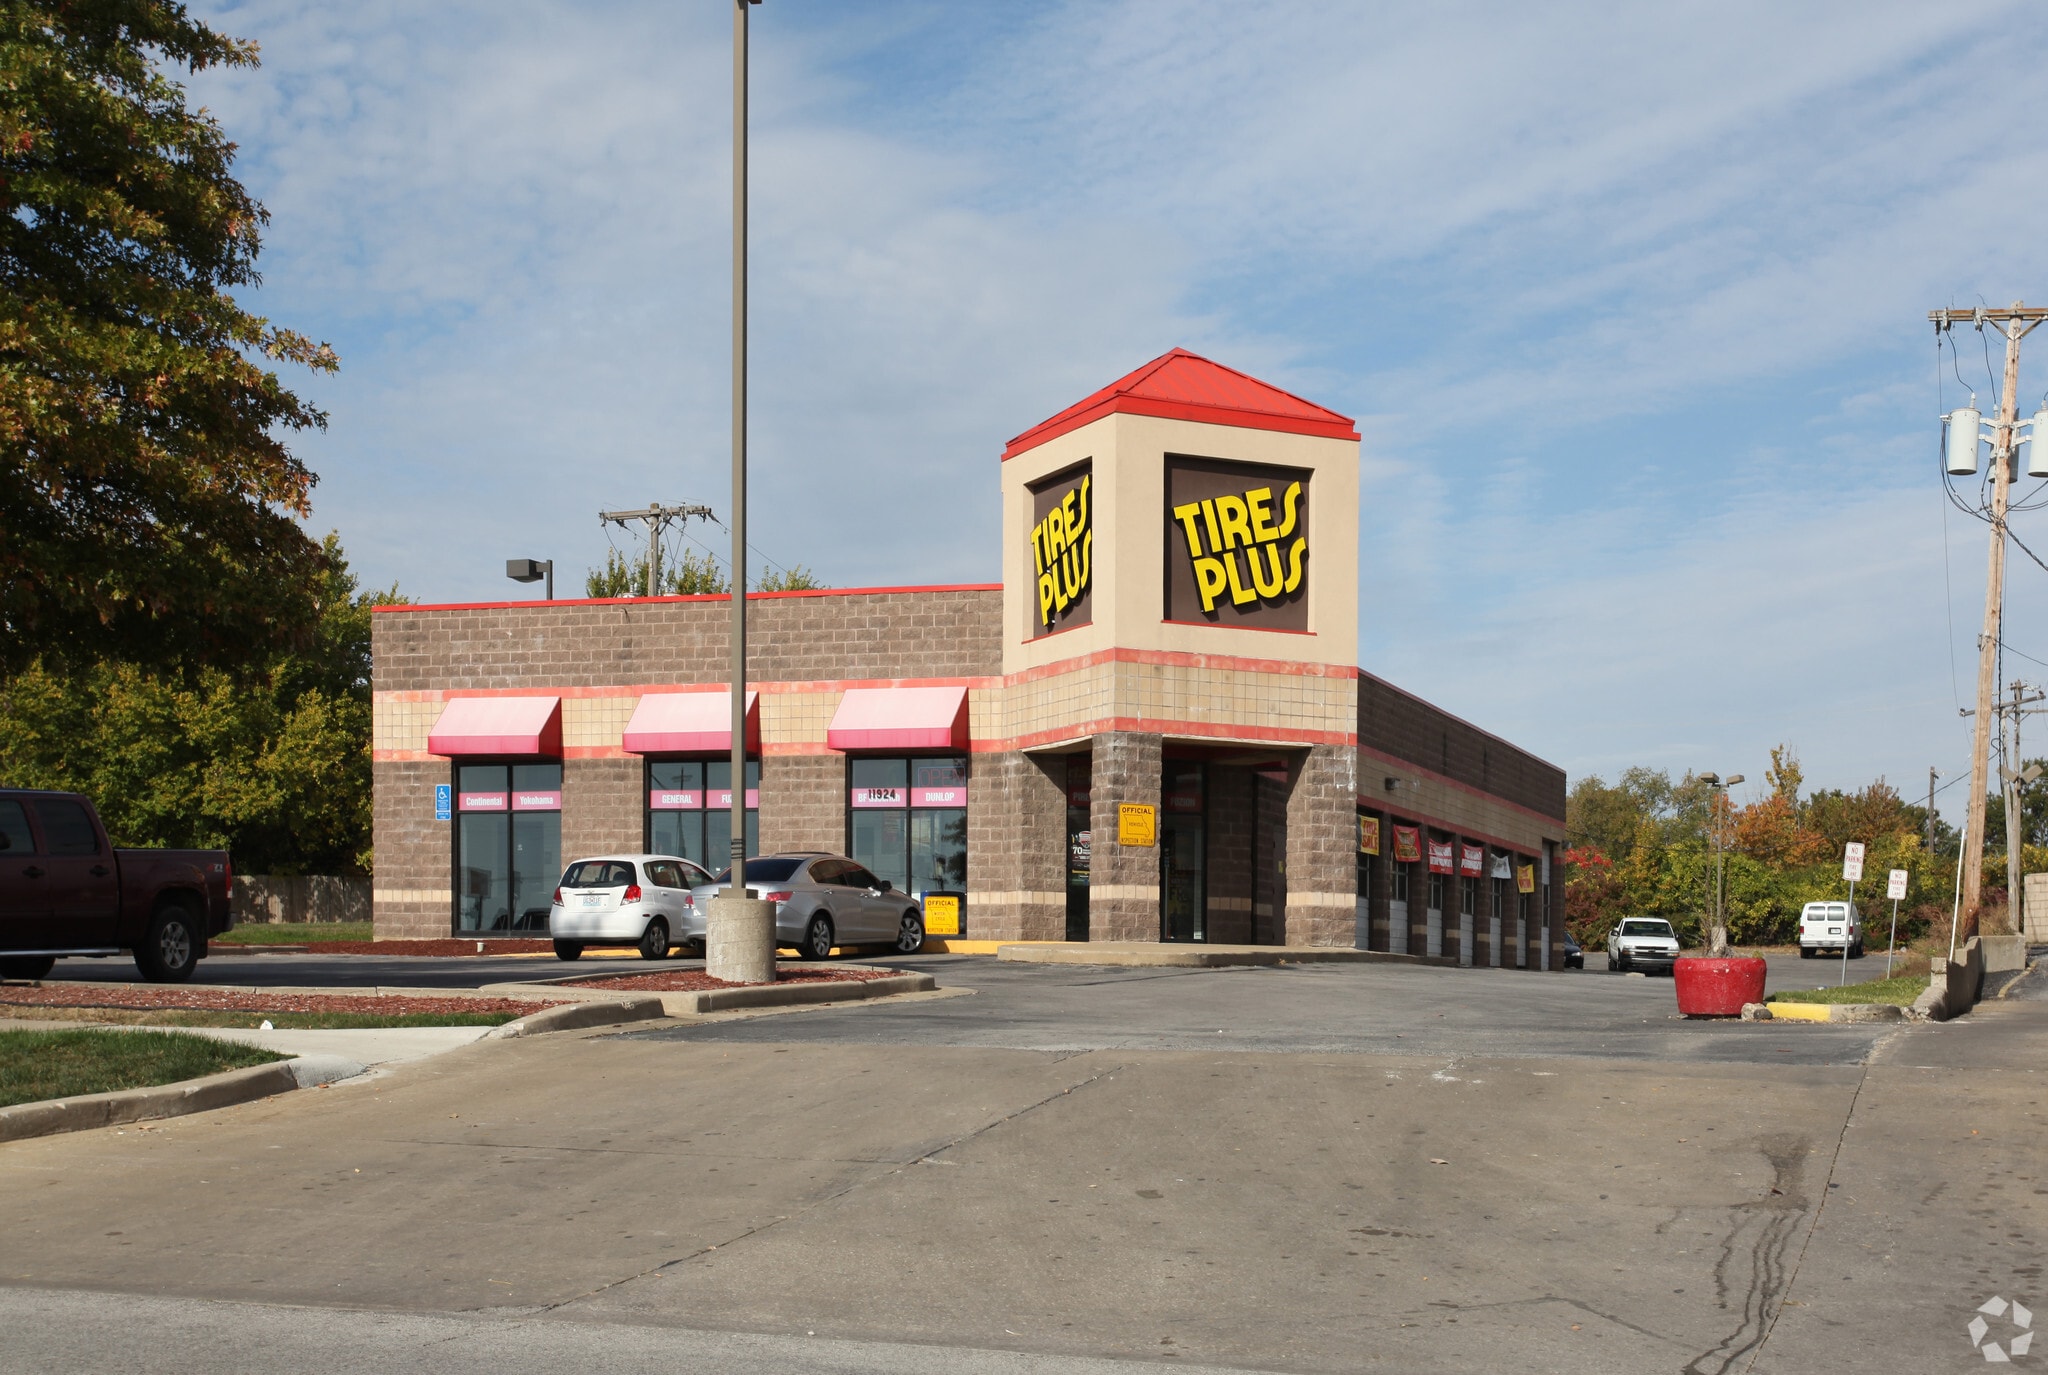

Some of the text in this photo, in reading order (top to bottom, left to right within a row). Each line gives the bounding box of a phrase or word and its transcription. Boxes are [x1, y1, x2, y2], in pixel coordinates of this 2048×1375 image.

[1173, 481, 1301, 557] TIRES
[1031, 474, 1090, 576] TIRES
[1038, 529, 1092, 626] PLUS
[1193, 536, 1307, 613] PLUS
[919, 768, 964, 787] OPEN
[661, 794, 693, 804] GENERAL
[868, 788, 896, 799] 11924
[925, 792, 955, 802] DUNLOP
[466, 796, 503, 806] Continental
[519, 796, 554, 805] Yokohama
[1121, 807, 1152, 815] OFFICIAL
